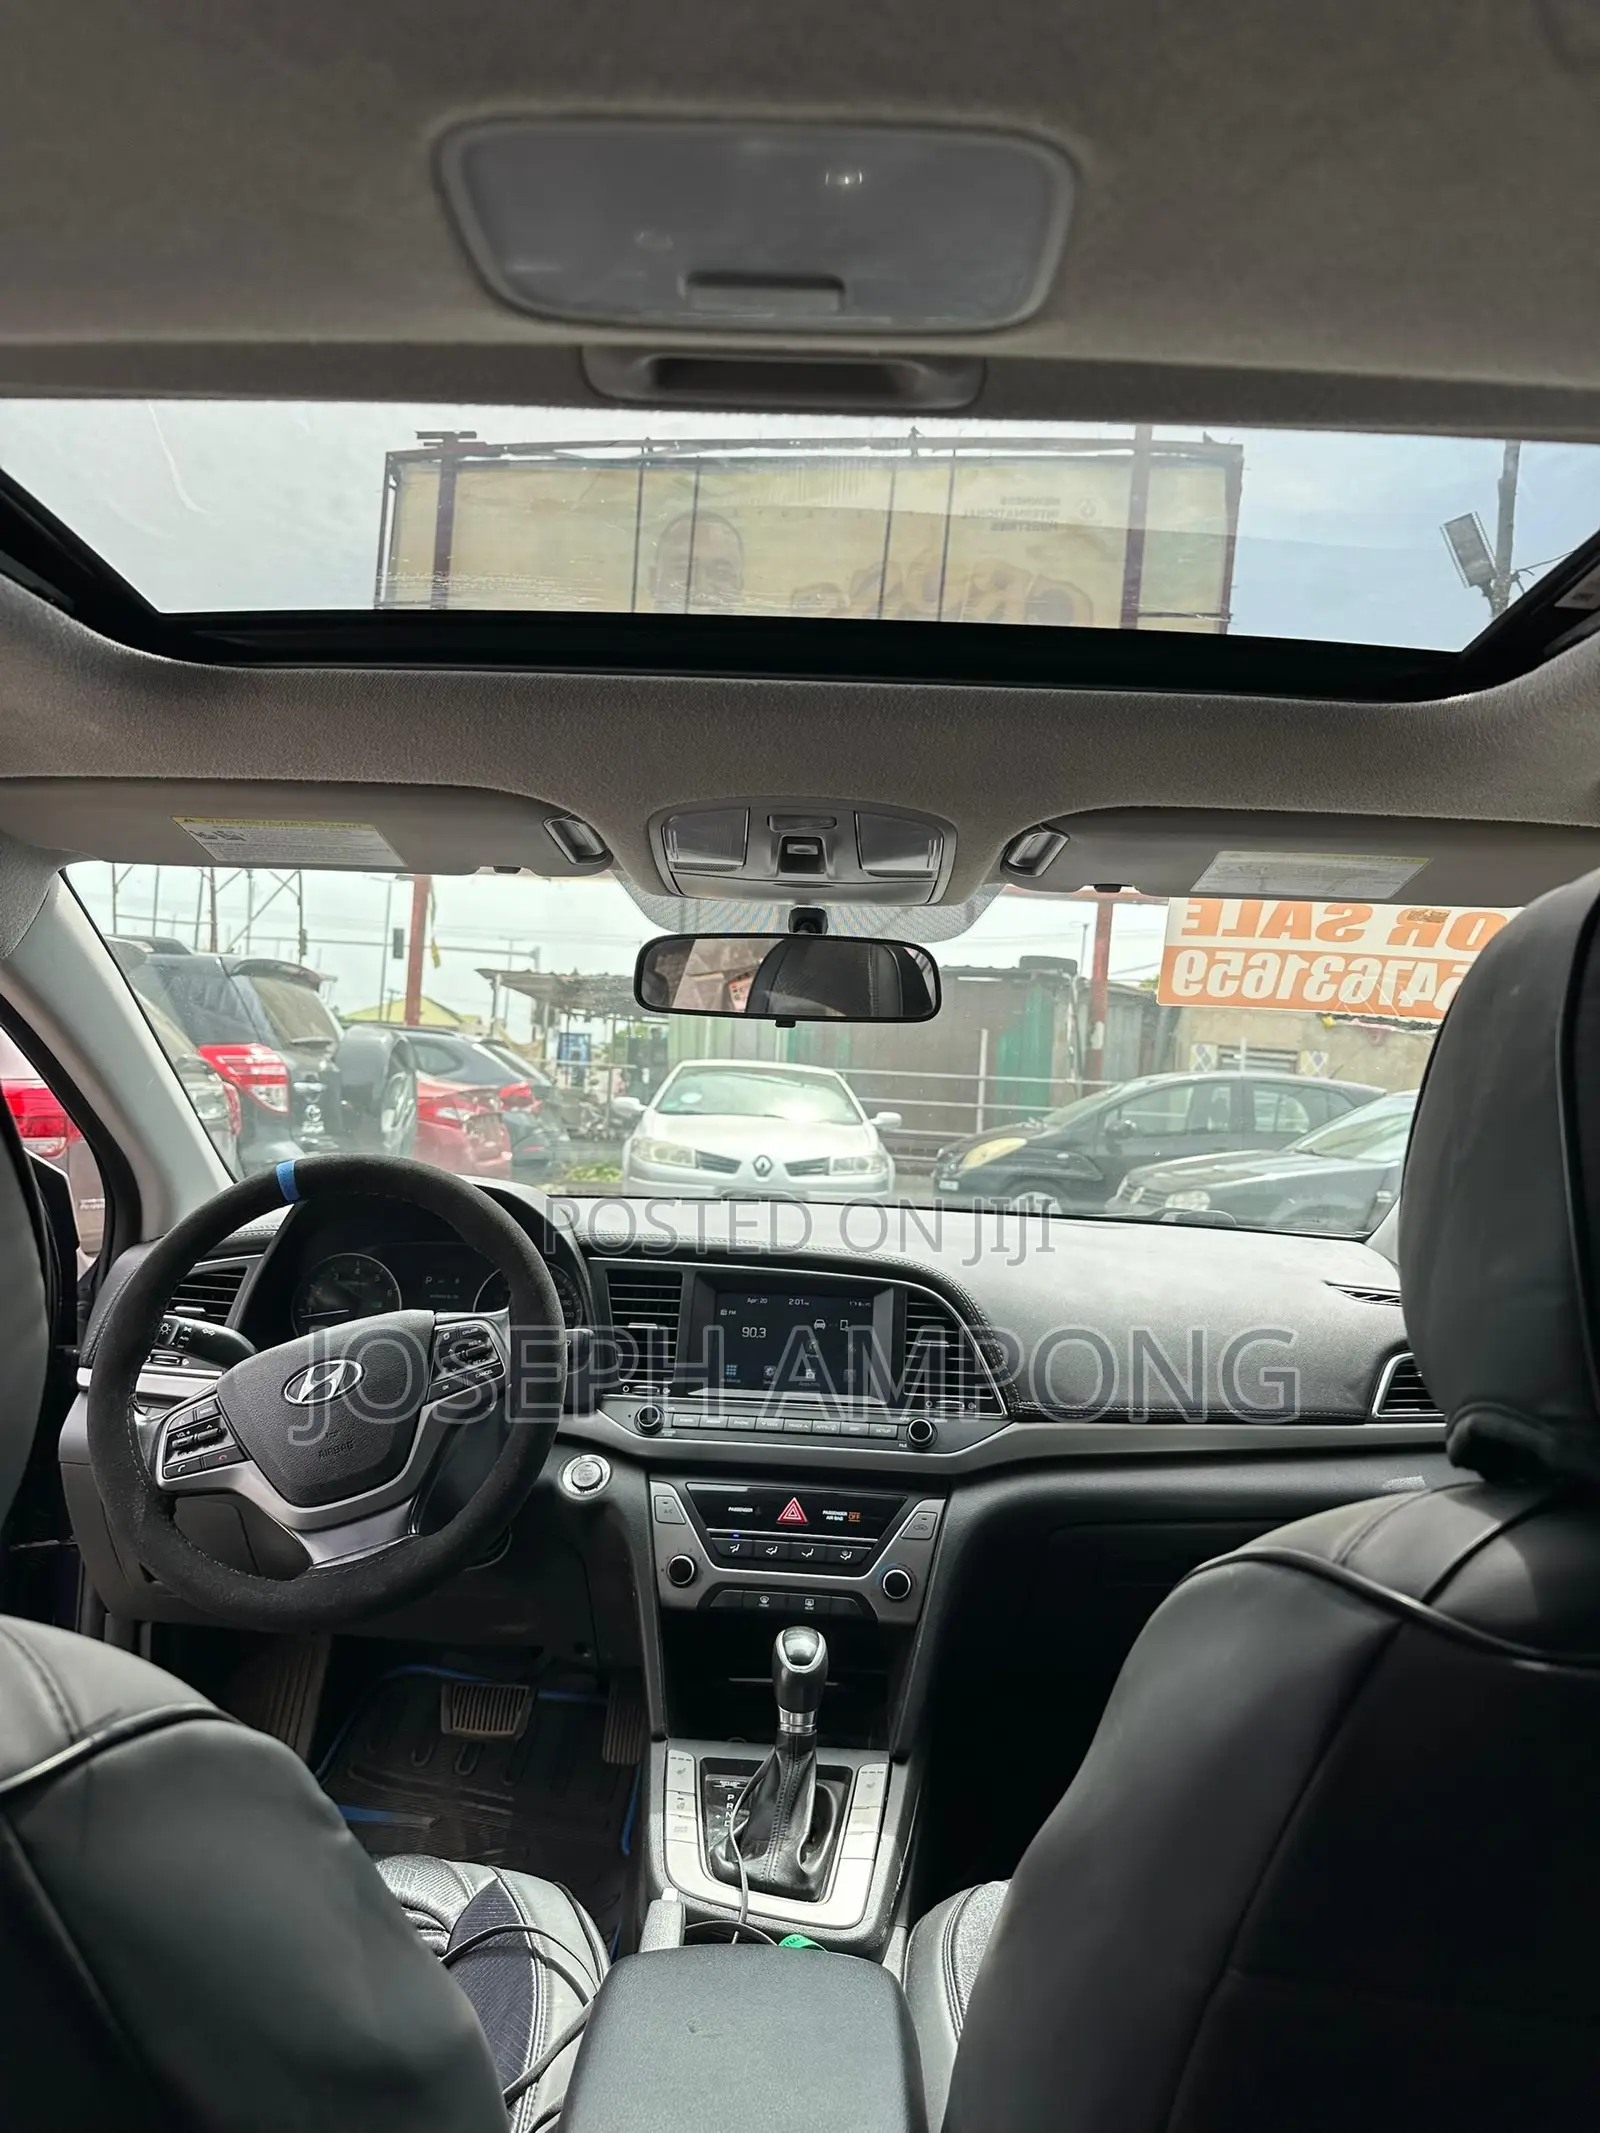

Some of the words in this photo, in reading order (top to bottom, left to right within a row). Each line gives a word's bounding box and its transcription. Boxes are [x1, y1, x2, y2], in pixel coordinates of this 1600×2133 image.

[742, 1326, 767, 1339] 90.3
[475, 1369, 494, 1378] CANCEL
[727, 1793, 735, 1801] P
[726, 1802, 734, 1810] R
[725, 1811, 733, 1819] N
